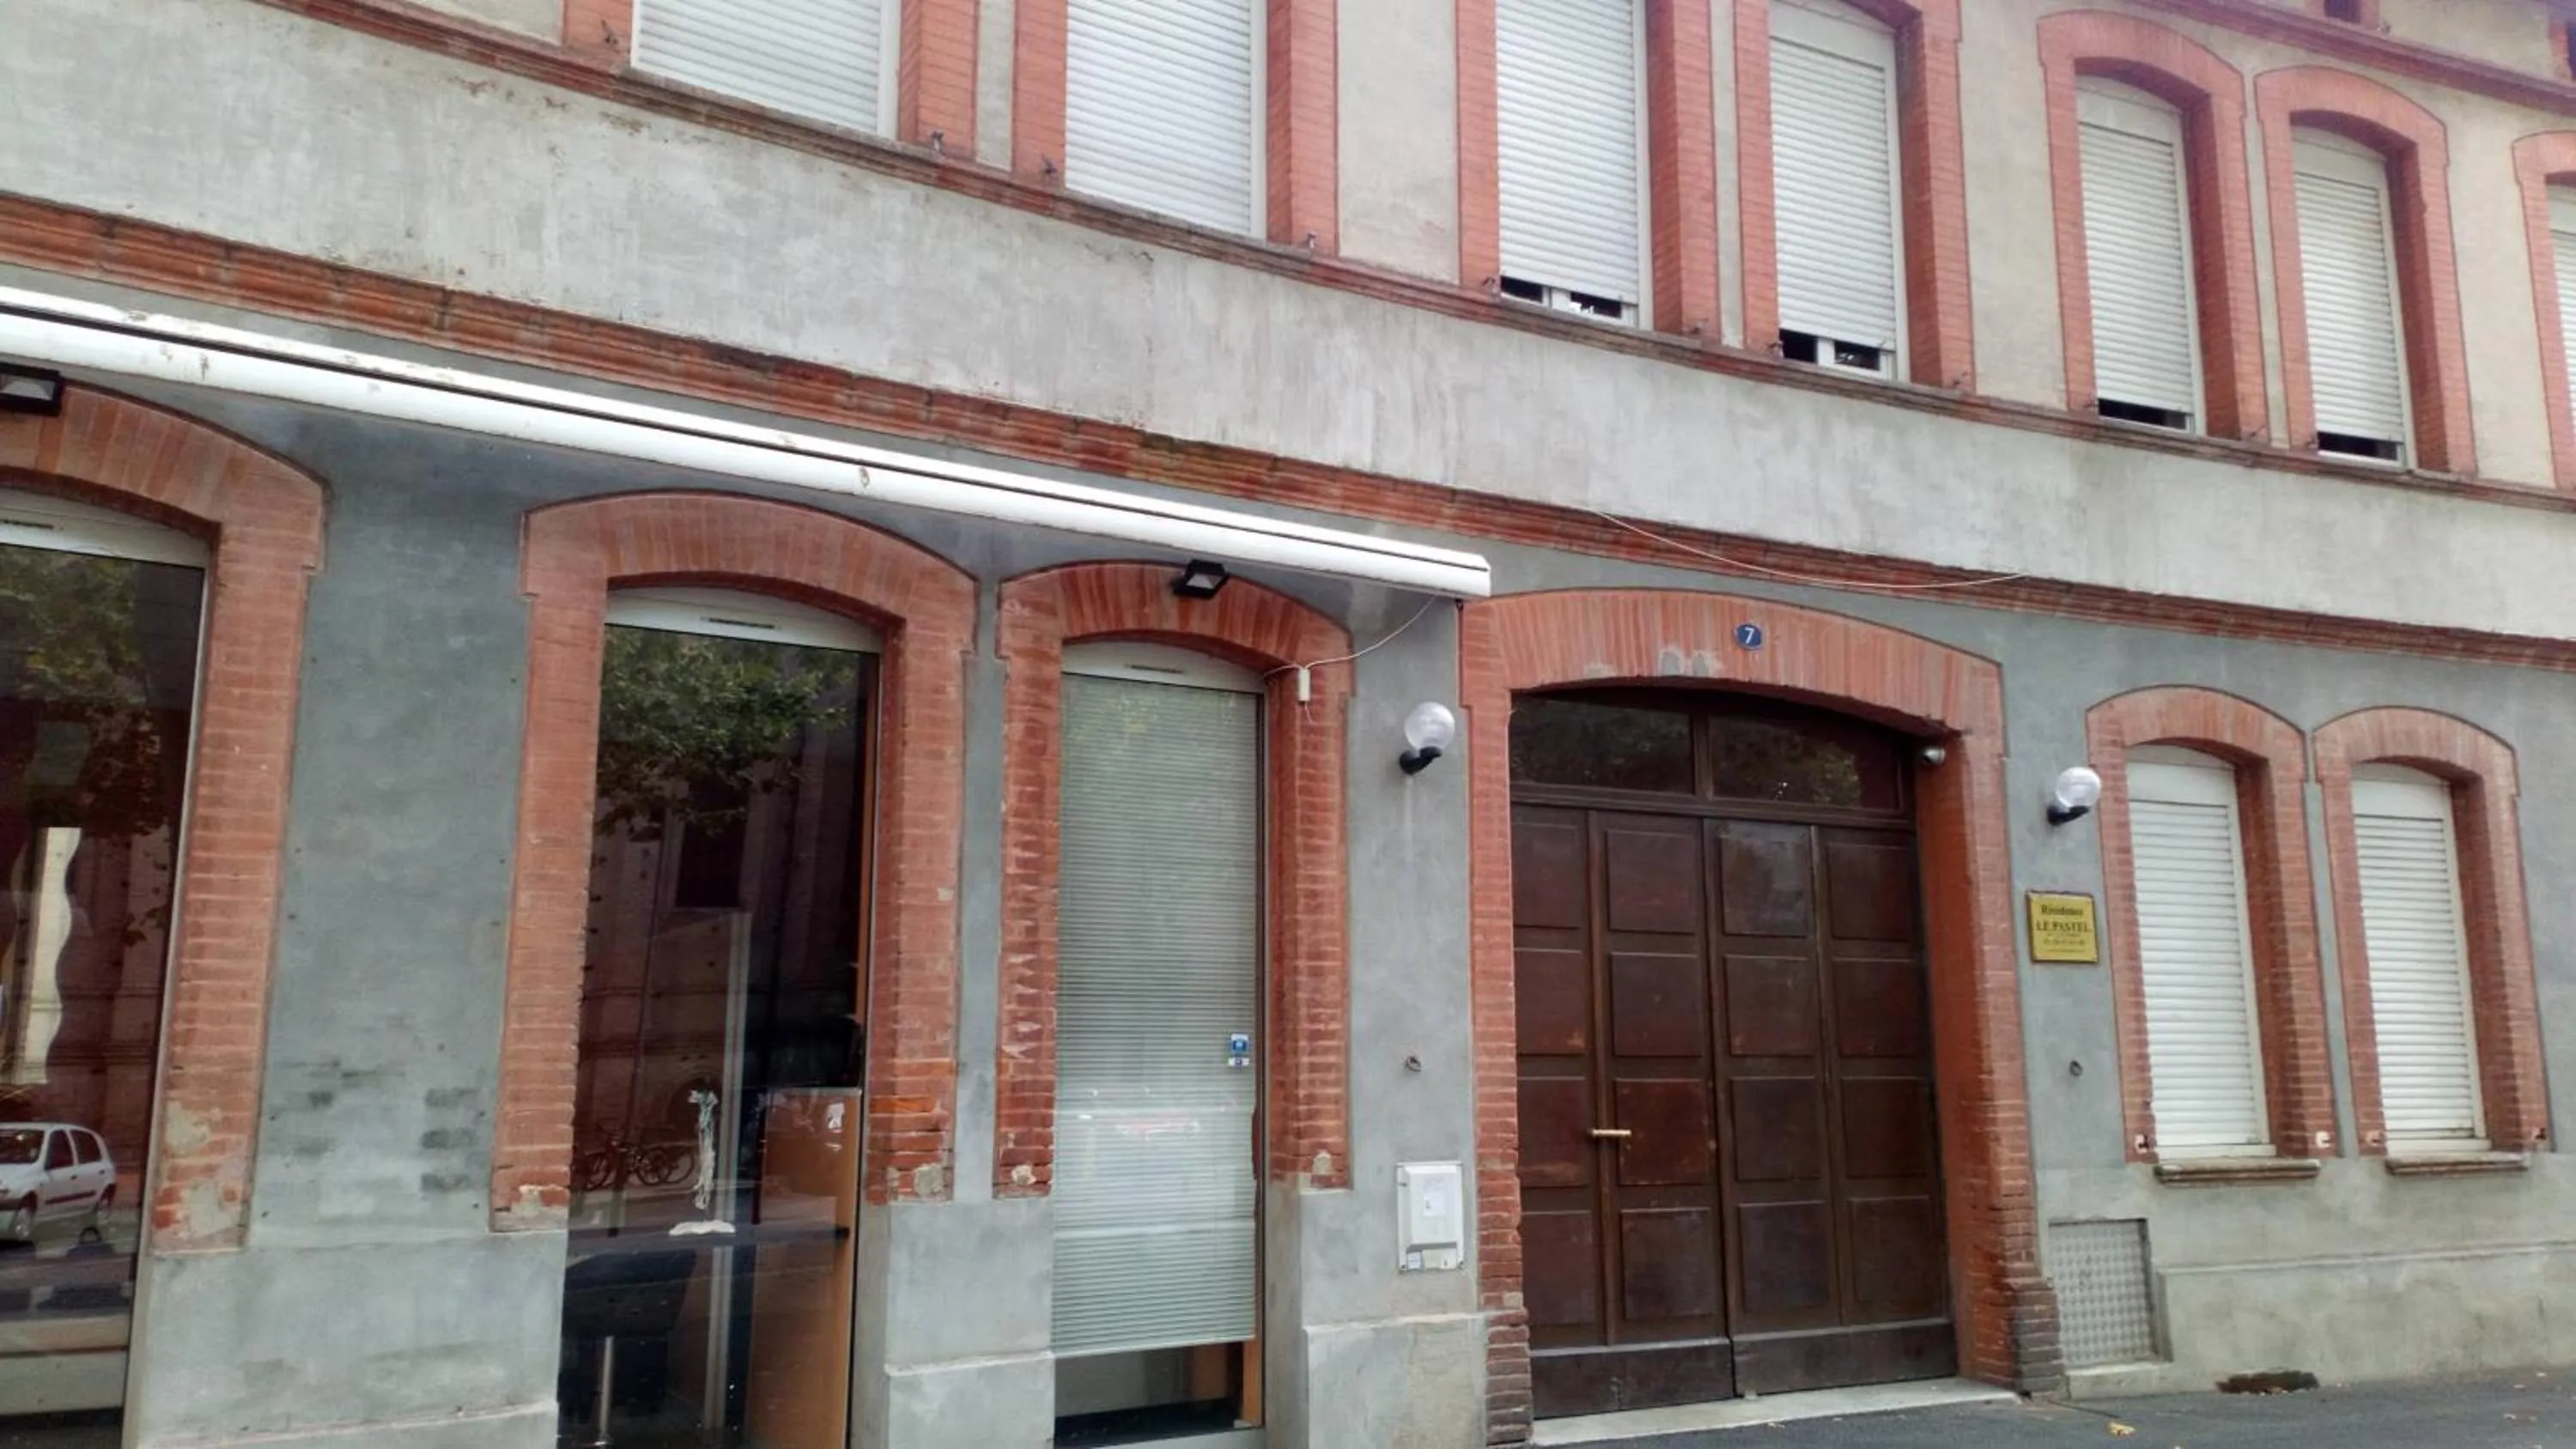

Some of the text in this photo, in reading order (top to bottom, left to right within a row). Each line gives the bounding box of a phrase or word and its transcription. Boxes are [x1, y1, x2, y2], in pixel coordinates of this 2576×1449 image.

[1744, 627, 1755, 644] 7
[2035, 920, 2092, 933] LE PASTEL
